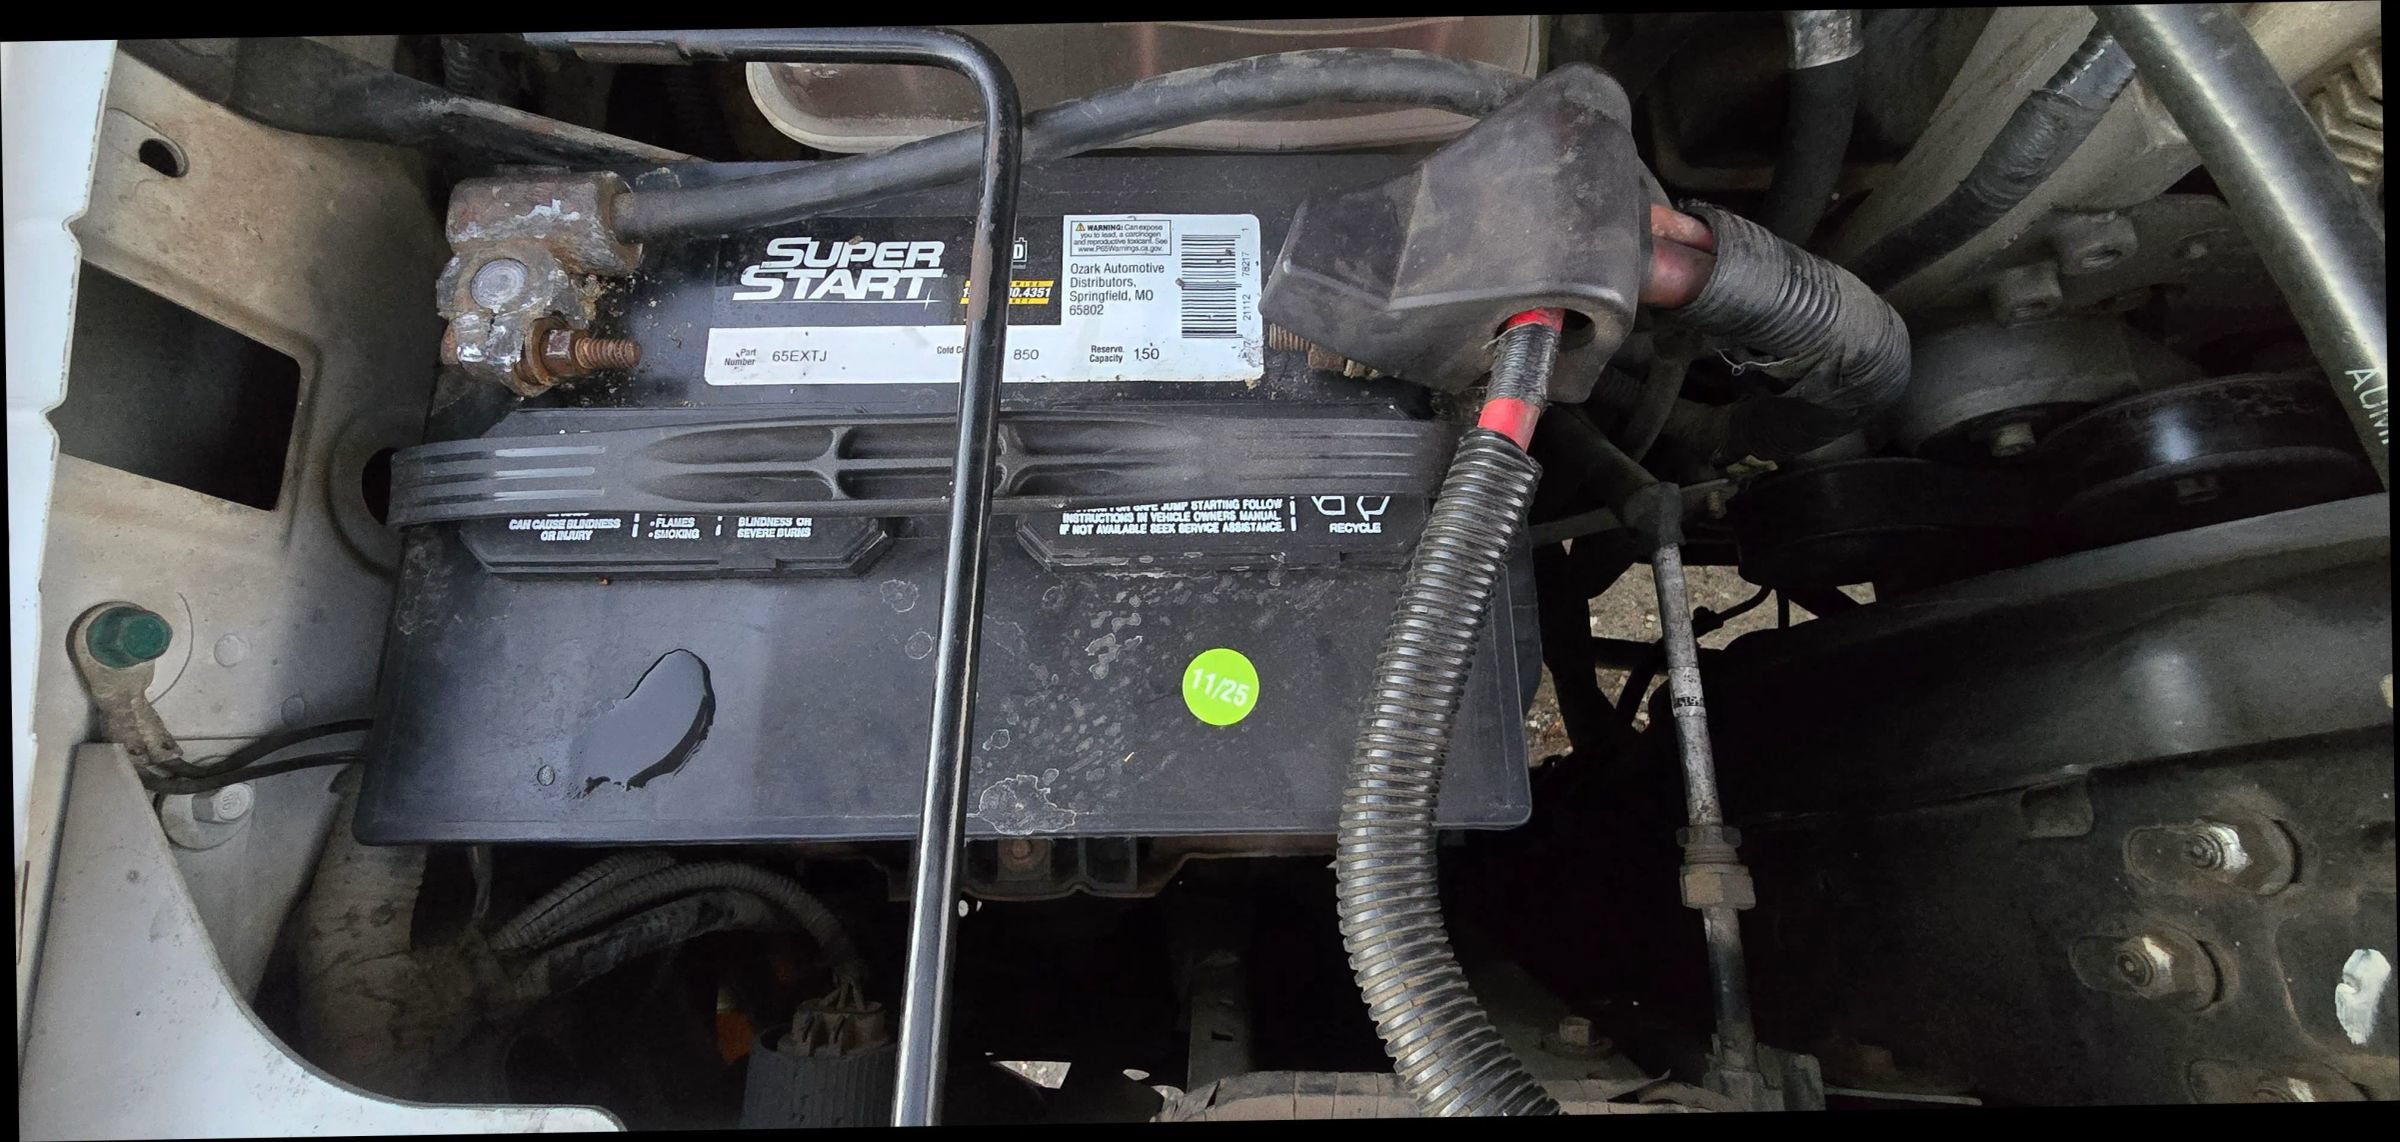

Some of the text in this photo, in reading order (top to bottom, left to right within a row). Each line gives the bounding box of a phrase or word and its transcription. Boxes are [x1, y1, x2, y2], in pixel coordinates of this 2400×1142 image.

[760, 236, 945, 268] SUPER
[1070, 263, 1165, 274] Ozark Automotive
[1241, 252, 1251, 277] 78217
[732, 265, 944, 300] START
[1070, 277, 1137, 288] Distributors,
[1069, 289, 1154, 303] Springfield, MO
[1069, 304, 1104, 316] 65802
[1242, 294, 1252, 321] 21112
[740, 348, 757, 356] Part
[936, 346, 954, 354] Cold
[1013, 348, 1040, 360] 850
[1091, 344, 1123, 353] Reserve
[1134, 348, 1160, 360] 150
[724, 358, 756, 366] Number
[772, 350, 827, 362] 65EXTJ
[1089, 354, 1123, 364] Capacity
[1161, 502, 1189, 512] JUMP
[1190, 499, 1240, 511] STARTING
[1242, 498, 1283, 510] FOLLOW
[738, 516, 812, 527] BLINDNESS OR
[1062, 512, 1134, 524] INSTRUCTIONS
[1136, 512, 1148, 523] IN
[1150, 510, 1191, 522] VEHICLE
[1193, 510, 1236, 522] OWNERS
[508, 518, 621, 530] CAN CAUSE BLINDNESS
[1059, 522, 1286, 536] IF NOT AVAILABLE SEEK SERVICE ASSISTANCE.
[1329, 522, 1382, 534] RECYCLE
[540, 530, 593, 541] OR INJURY
[736, 527, 812, 538] SEVERE BURNS
[1192, 668, 1249, 707] 11/25
